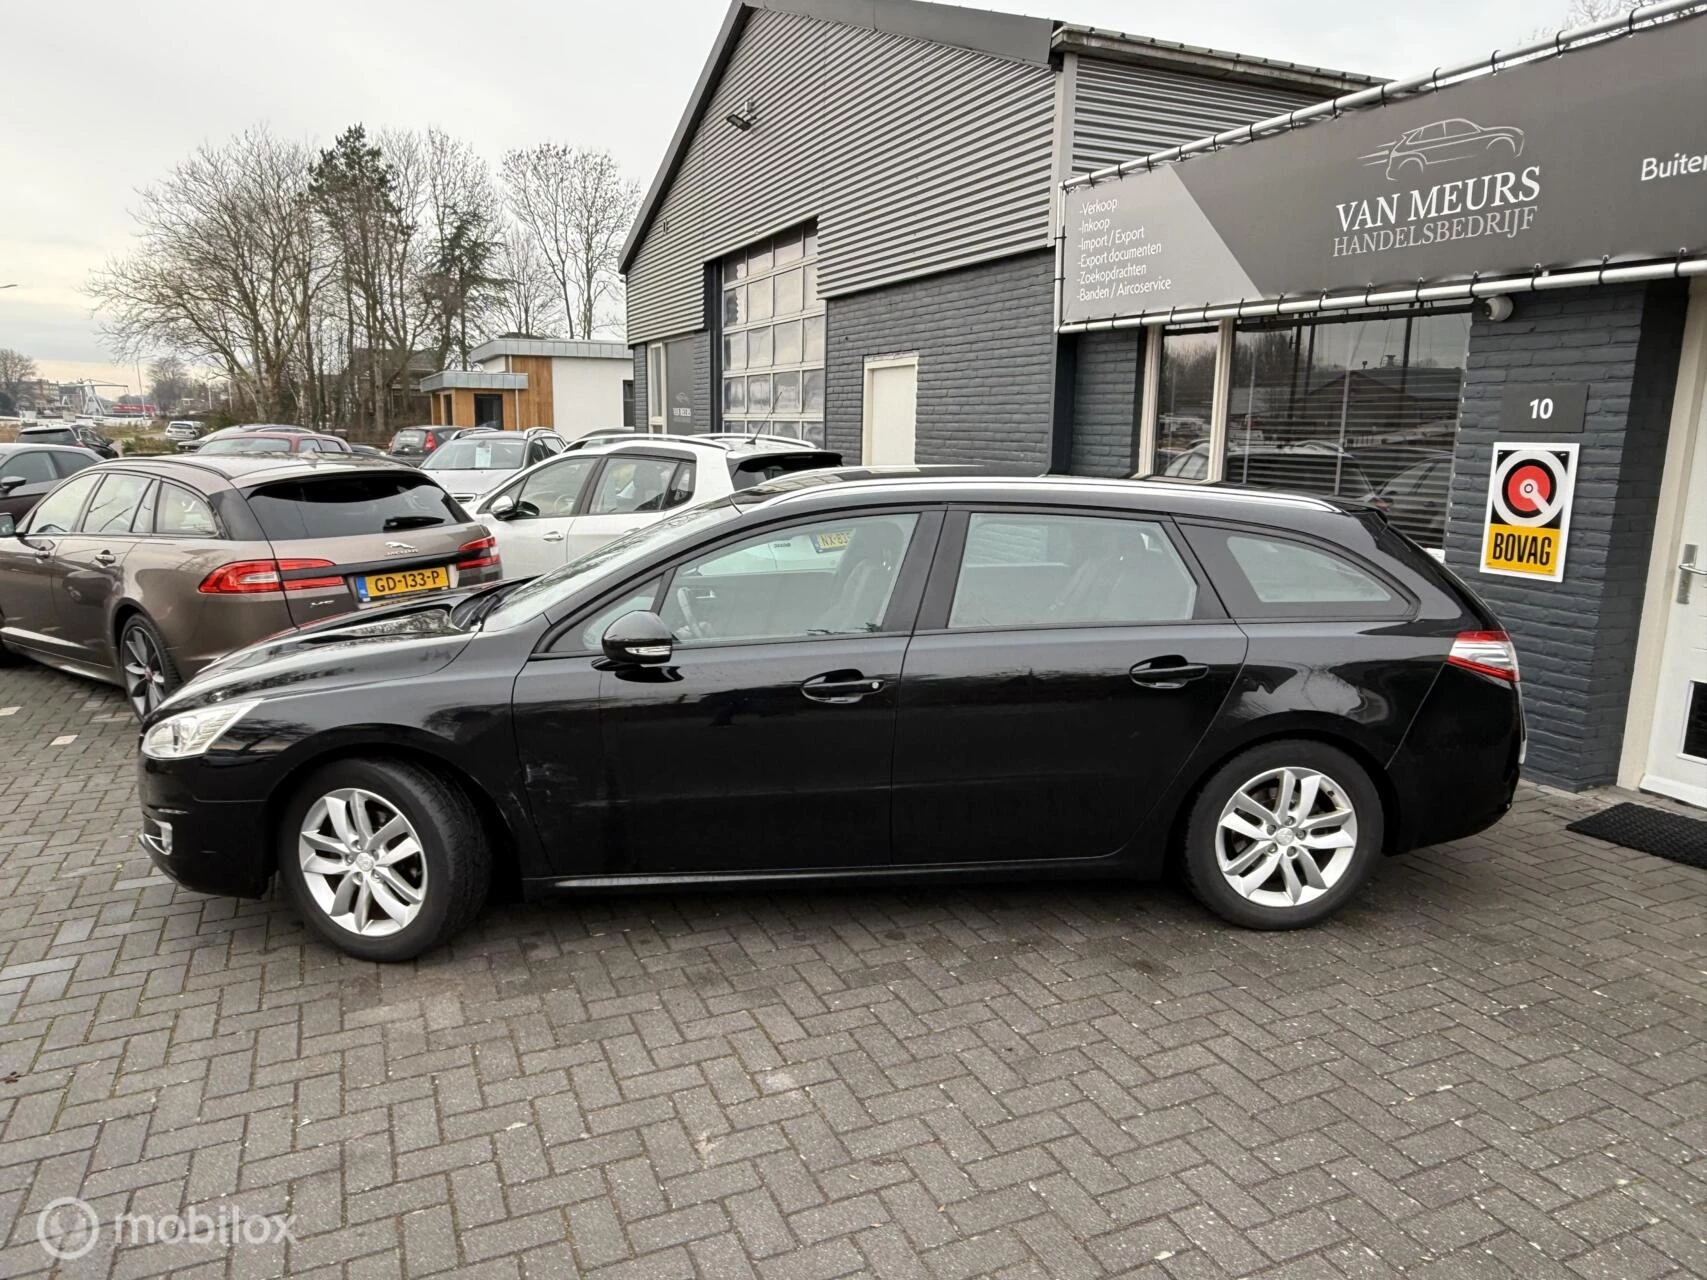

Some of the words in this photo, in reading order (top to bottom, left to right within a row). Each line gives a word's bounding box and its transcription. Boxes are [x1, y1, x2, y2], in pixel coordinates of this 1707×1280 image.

[1336, 193, 1401, 232] VAN
[1407, 165, 1541, 222] MEURS
[1115, 225, 1144, 245] Export
[1333, 205, 1538, 257] HANDELSBEDRIJF
[1108, 242, 1162, 263] documenten
[1116, 275, 1172, 297] Aircoservice
[1529, 398, 1554, 420] 10
[1492, 532, 1552, 566] BOVAG
[374, 570, 440, 593] GD-133-P
